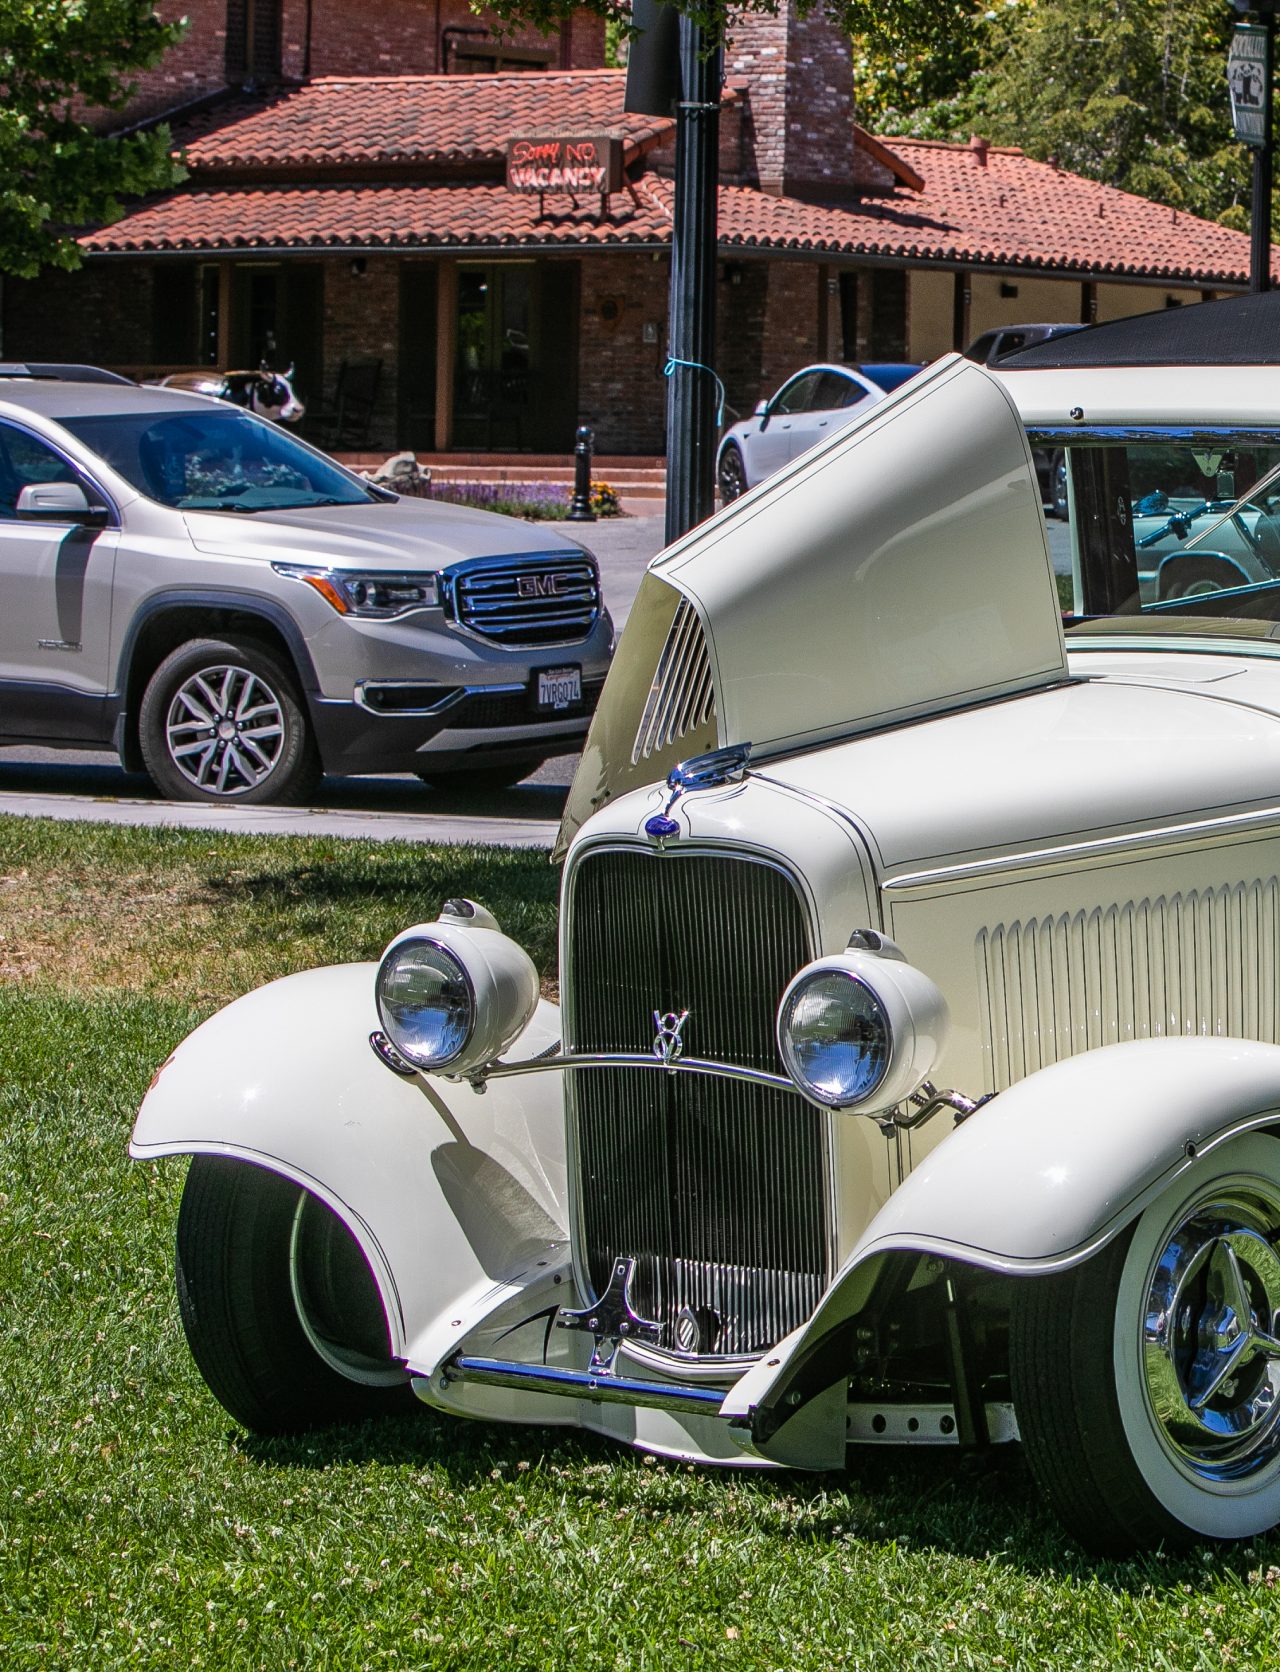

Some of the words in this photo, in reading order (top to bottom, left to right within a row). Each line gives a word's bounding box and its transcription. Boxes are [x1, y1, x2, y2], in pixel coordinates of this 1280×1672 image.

[566, 142, 596, 161] NO
[509, 166, 606, 187] VACANCY
[517, 574, 569, 597] GMC
